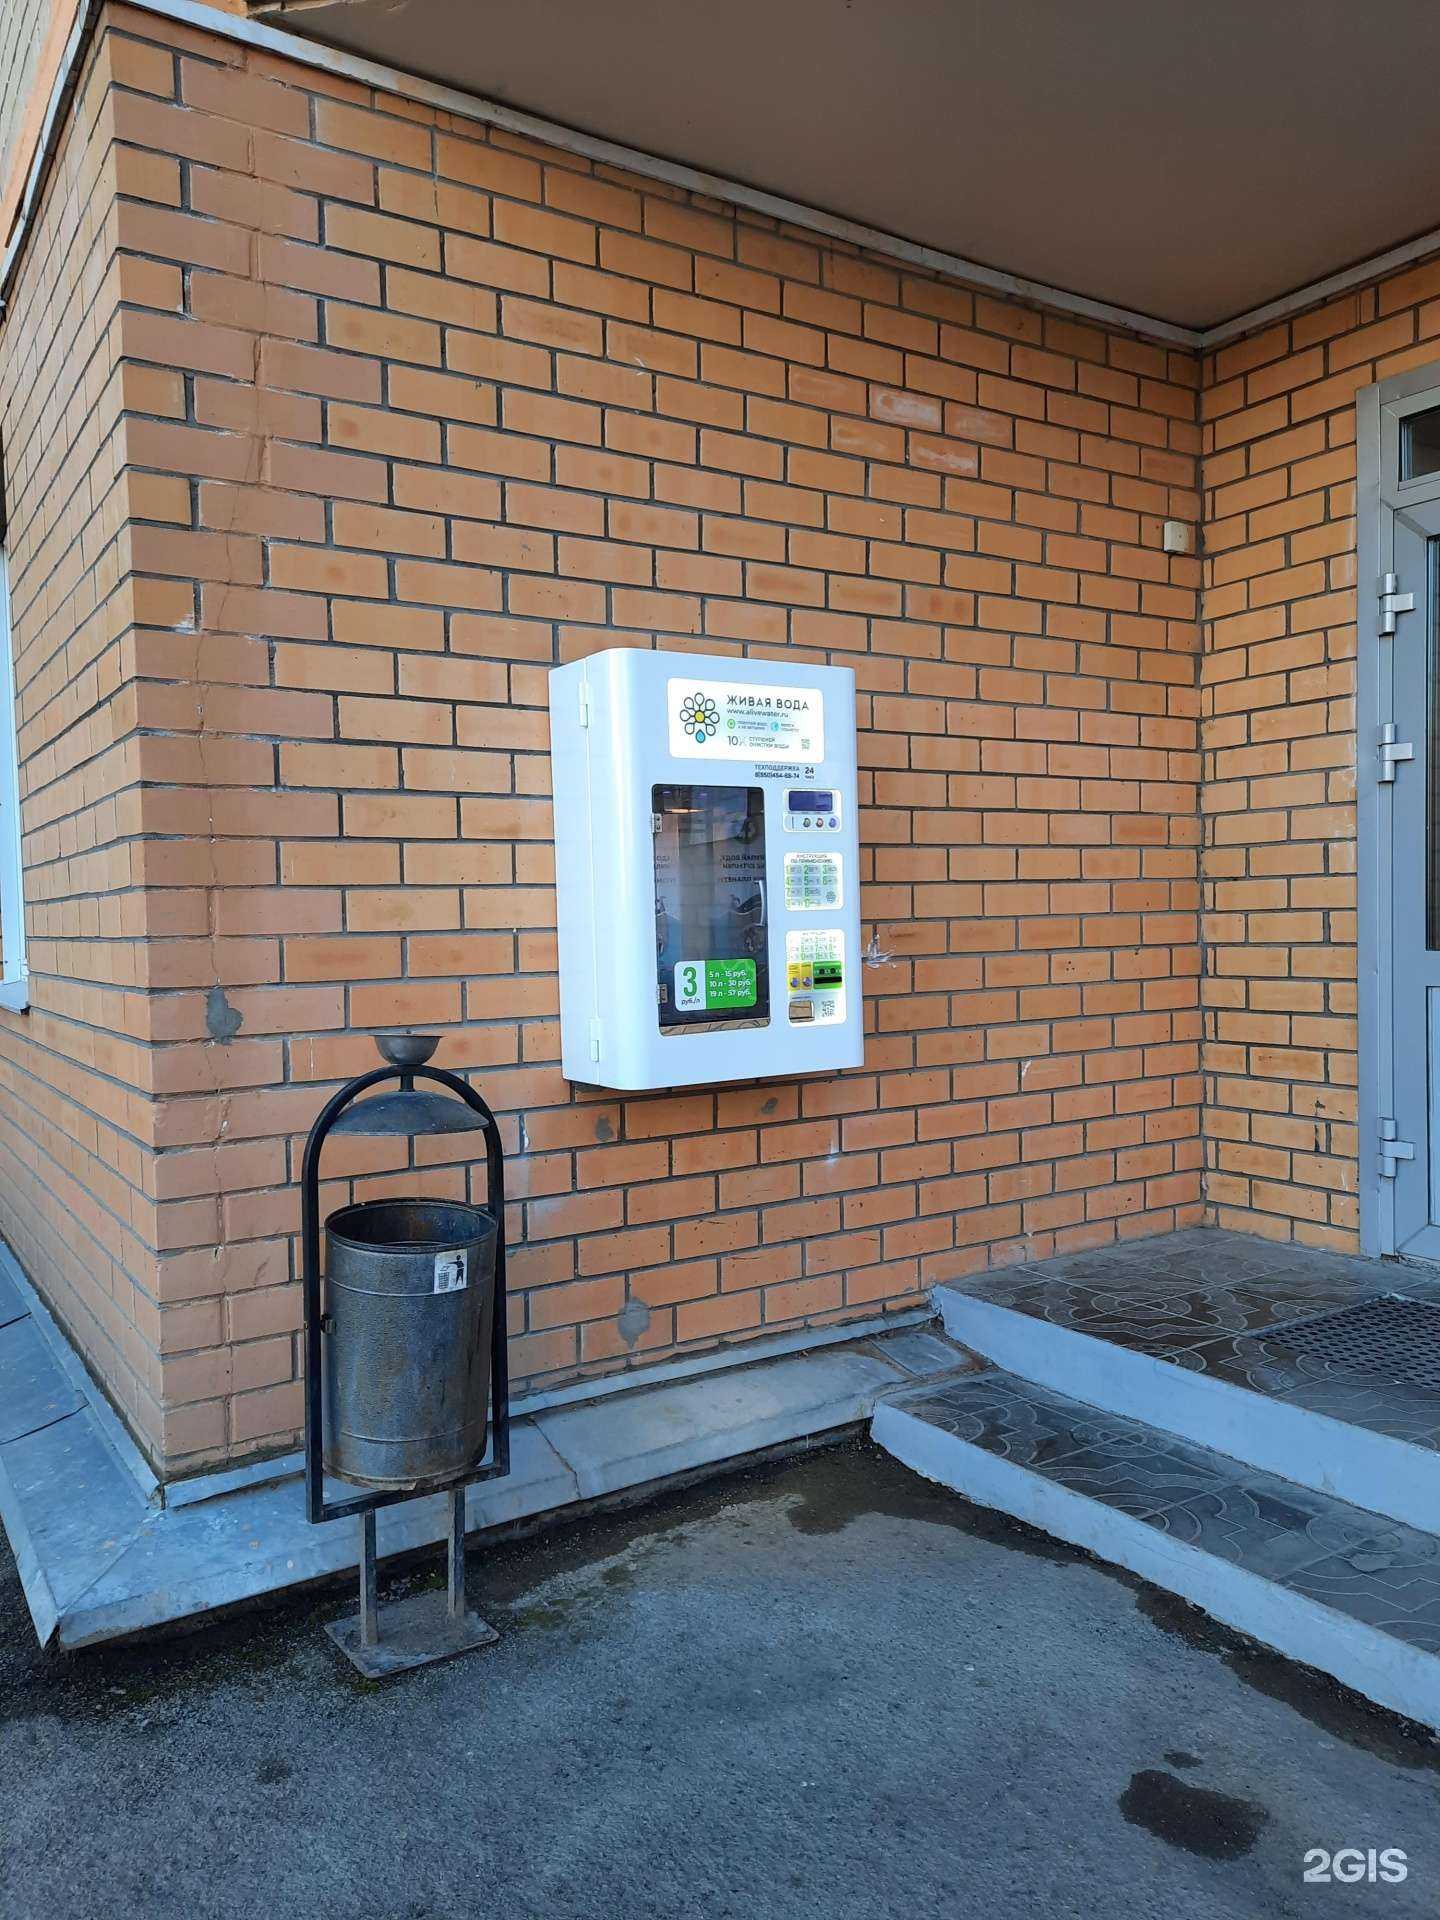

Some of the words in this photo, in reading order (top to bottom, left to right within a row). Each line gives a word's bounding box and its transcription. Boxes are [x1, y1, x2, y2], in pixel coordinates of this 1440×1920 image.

[727, 694, 771, 707] ЖИВАЯ
[776, 698, 809, 711] ВОДА
[727, 708, 789, 718] www.alivewater.ru
[804, 766, 815, 775] 24
[683, 967, 698, 997] 3
